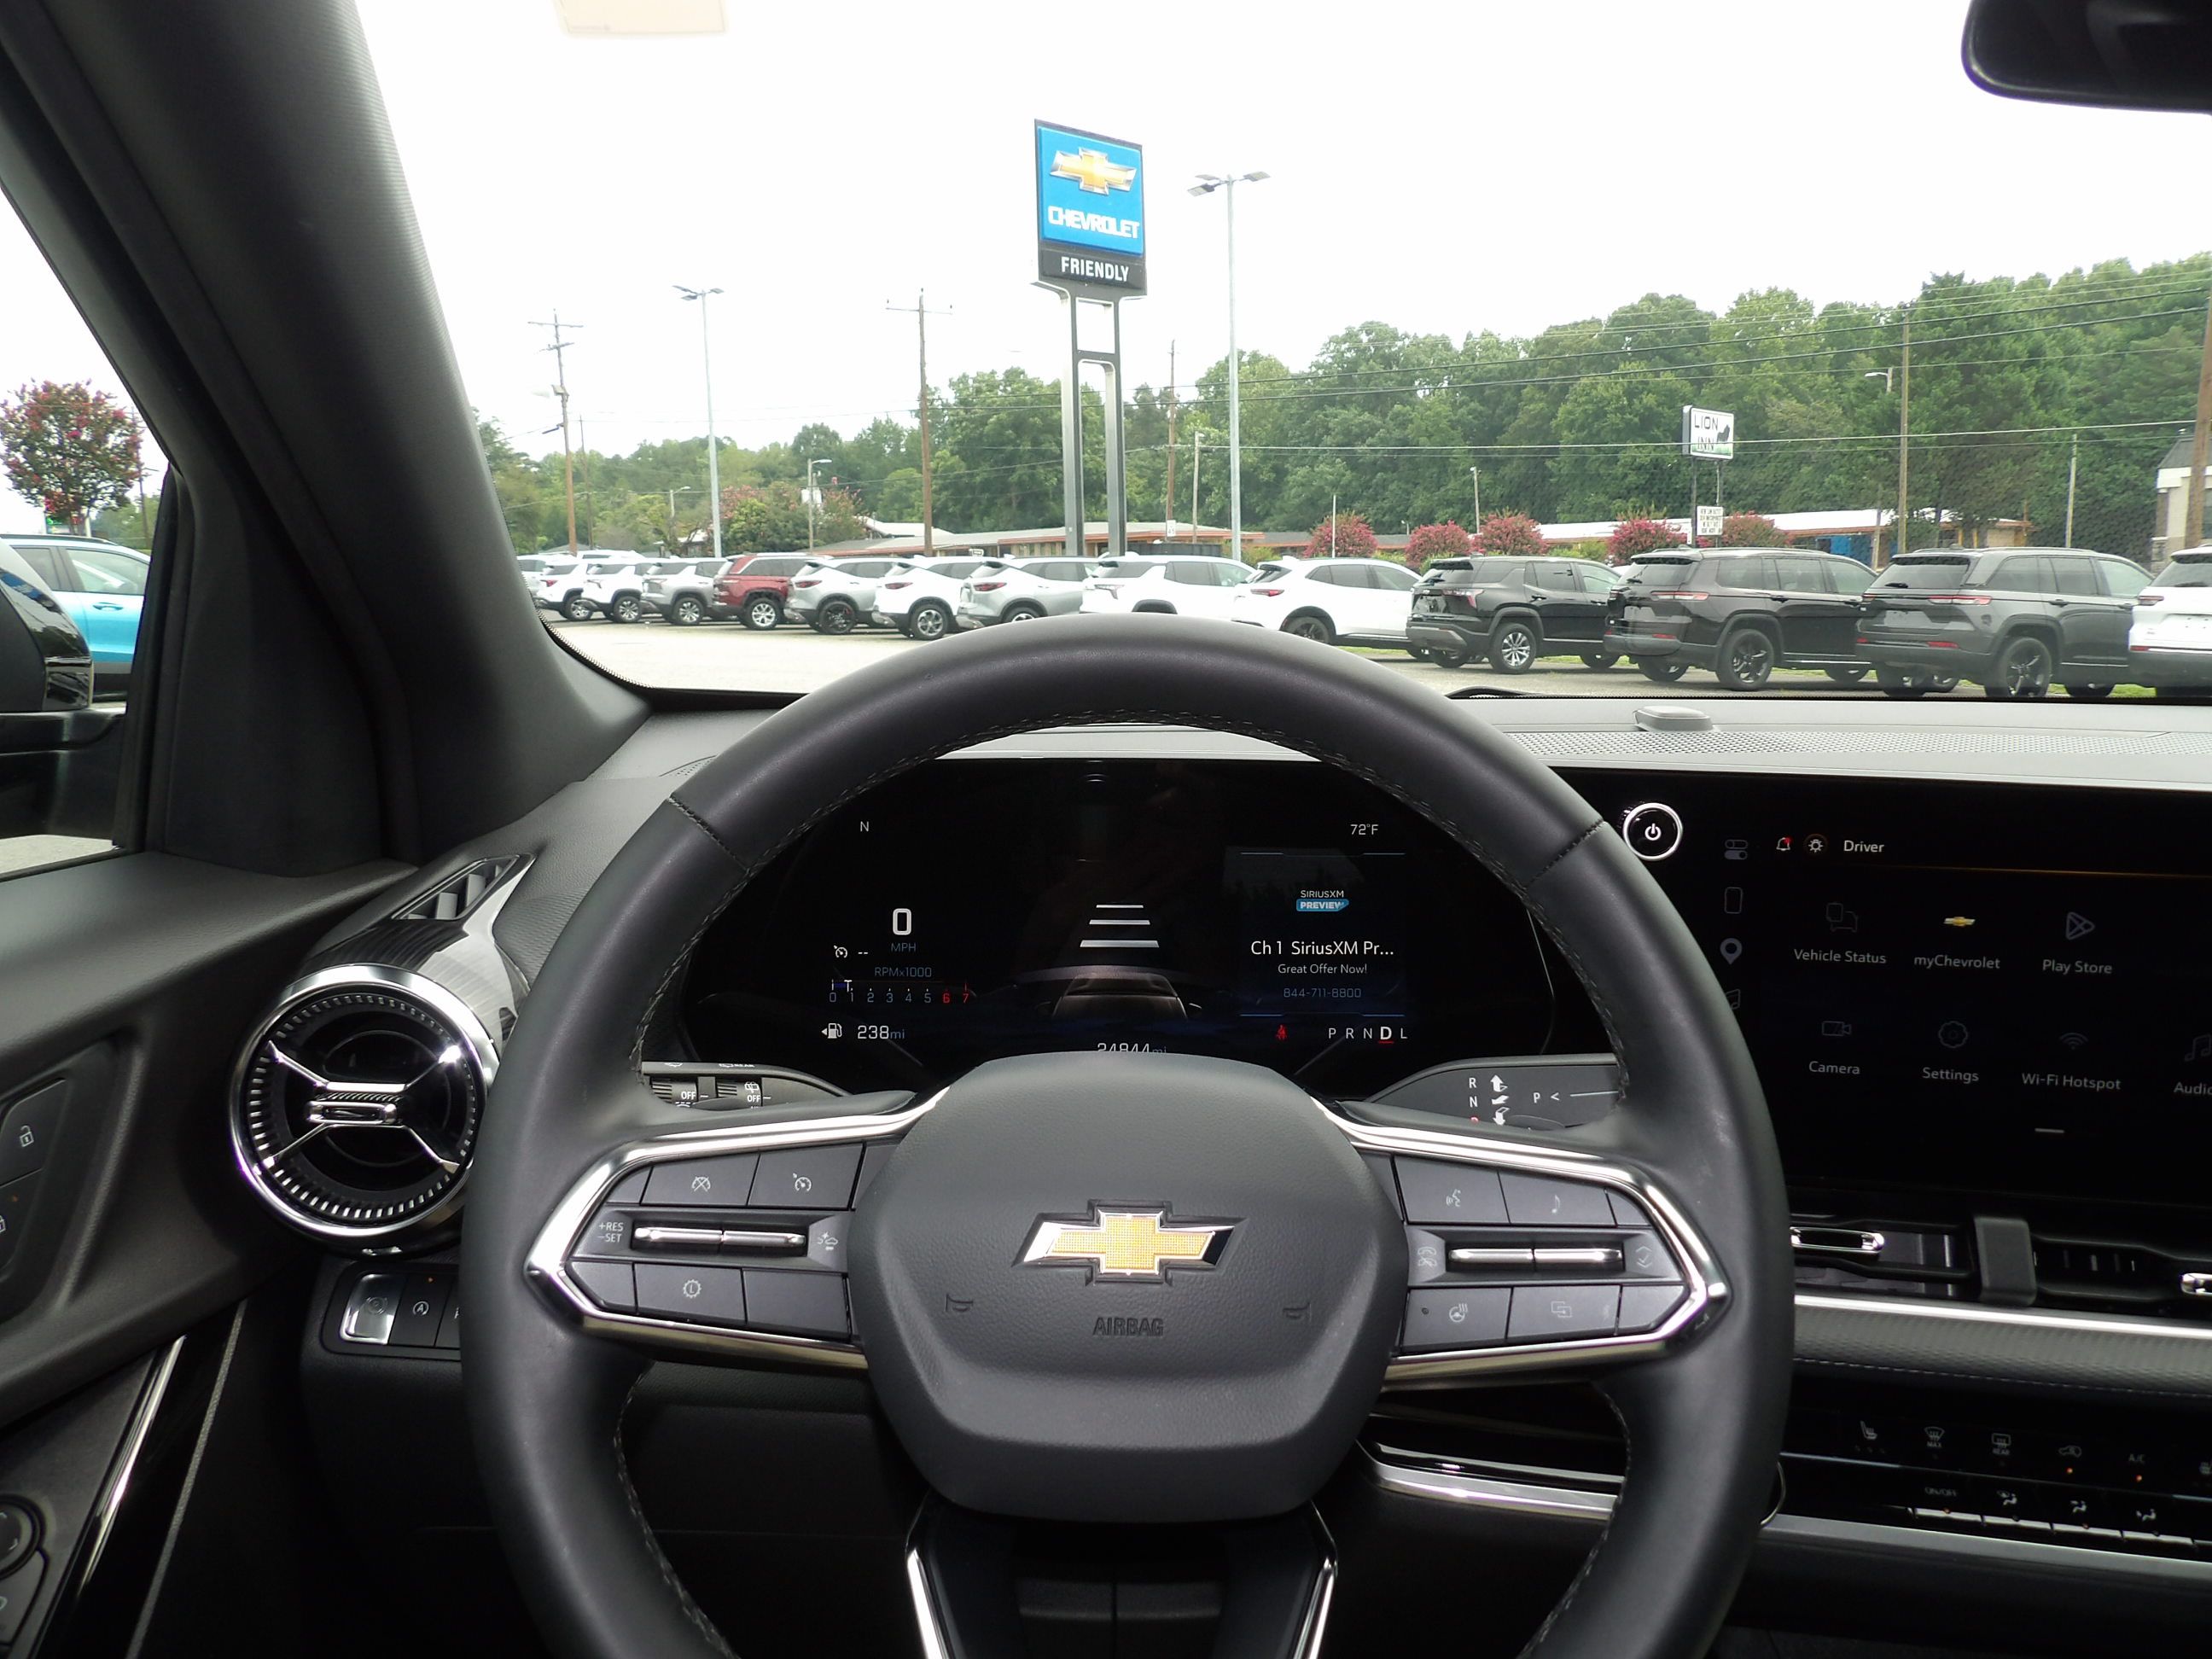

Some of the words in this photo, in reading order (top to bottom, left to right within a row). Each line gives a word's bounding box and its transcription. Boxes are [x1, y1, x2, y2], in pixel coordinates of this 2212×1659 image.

[1047, 205, 1140, 239] CHEVROLET
[1061, 256, 1129, 282] FRIENDLY
[1694, 414, 1719, 431] LION
[1698, 436, 1714, 451] INN
[860, 821, 870, 832] N
[1350, 824, 1379, 835] 72°F
[1843, 840, 1884, 853] Driver
[1300, 901, 1345, 910] PREVIEW
[893, 908, 912, 935] 0
[890, 943, 917, 952] MPH
[1250, 940, 1272, 955] Ch
[1277, 941, 1282, 955] 1
[1291, 940, 1359, 955] SiriusXM
[1364, 941, 1394, 955] Pr...
[1794, 949, 1842, 962] Vehicle
[1844, 951, 1887, 964] Status
[1913, 954, 2000, 969] myChevrolet
[874, 967, 932, 978] RPMx1000
[1278, 963, 1307, 974] Great
[1309, 963, 1336, 974] Offer
[1341, 963, 1367, 974] Now!
[2042, 958, 2071, 975] Play
[2075, 960, 2113, 974] Store
[830, 992, 836, 1003] 0
[867, 992, 875, 1003] 2
[886, 992, 894, 1003] 3
[905, 992, 912, 1003] 4
[924, 992, 931, 1003] 5
[942, 993, 950, 1004] 6
[963, 993, 969, 1004] 7
[1284, 988, 1362, 998] 844-711-8800
[1328, 1027, 1336, 1039] P
[1346, 1027, 1354, 1039] R
[1363, 1027, 1372, 1039] N
[1380, 1026, 1393, 1040] D
[1400, 1028, 1408, 1039] L
[1808, 1061, 1860, 1074] Camera
[1922, 1067, 1980, 1084] Settings
[2021, 1073, 2059, 1086] Wi-Fi
[2063, 1075, 2122, 1091] Hotspot
[1469, 1078, 1476, 1088] R
[681, 1091, 696, 1100] OFF
[1469, 1096, 1478, 1108] N
[1534, 1092, 1540, 1103] P
[1092, 1317, 1164, 1336] AIRBAG
[1925, 1487, 1957, 1496] ON/OFF
